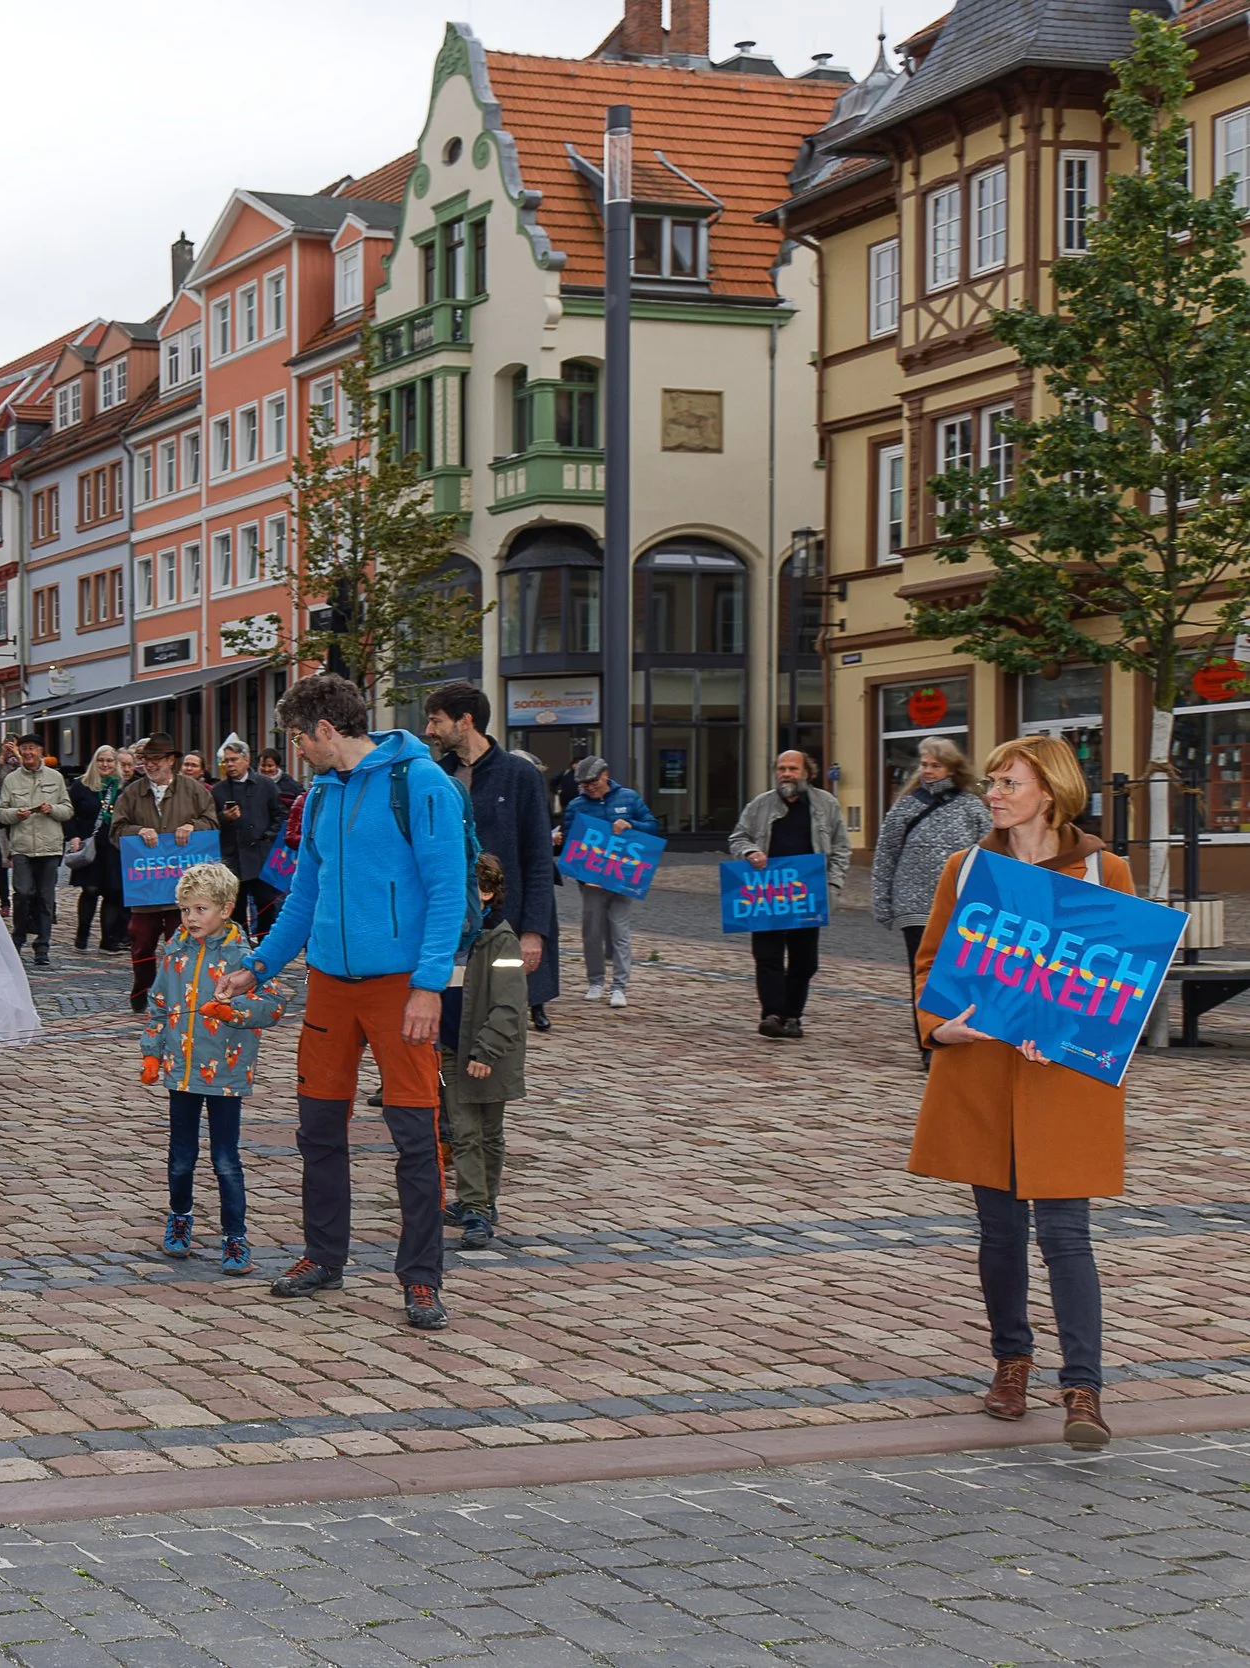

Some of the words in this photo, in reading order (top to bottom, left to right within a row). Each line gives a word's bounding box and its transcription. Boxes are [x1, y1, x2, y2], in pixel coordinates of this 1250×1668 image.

[565, 840, 653, 885] PEKT
[583, 828, 646, 866] RES
[740, 881, 807, 905] SIND
[744, 868, 798, 889] WIR
[733, 896, 816, 919] DABEI
[957, 902, 1157, 1000] GERECH
[955, 930, 1142, 1025] TIGKEIT
